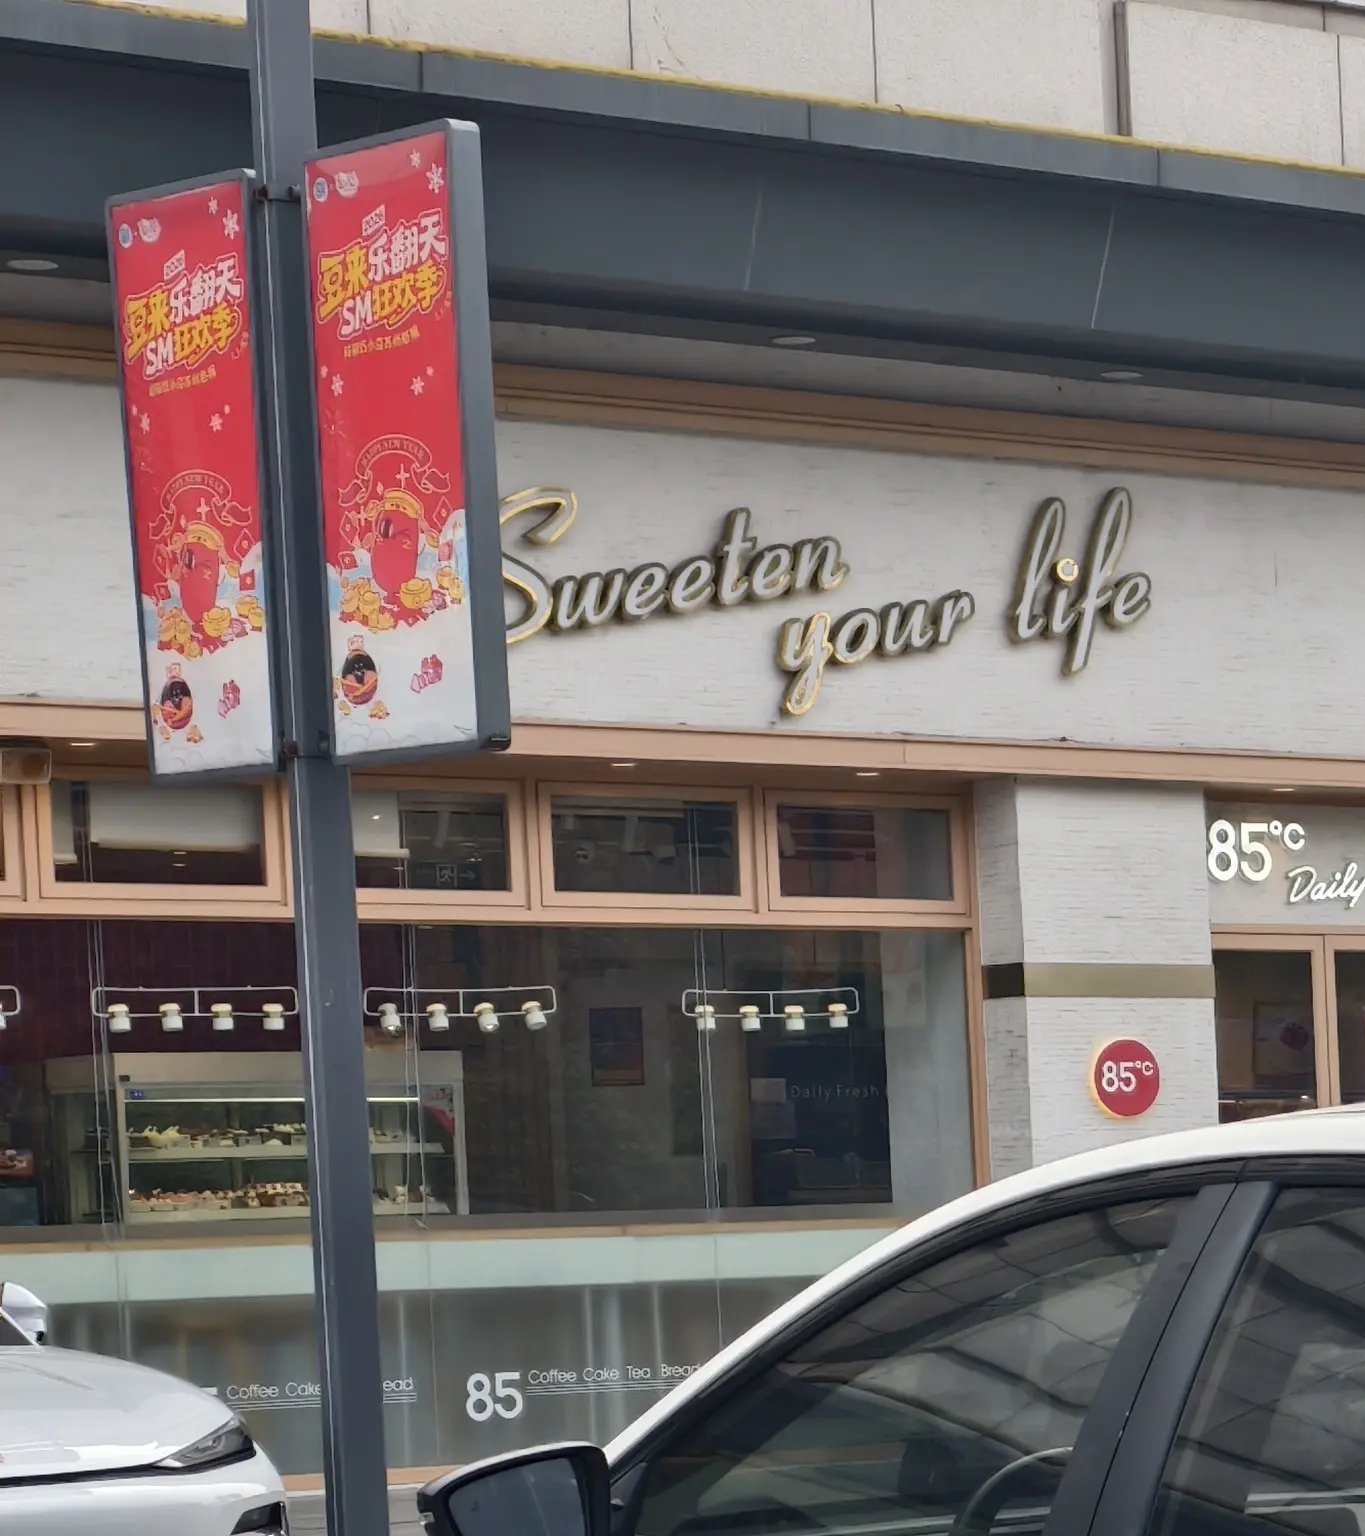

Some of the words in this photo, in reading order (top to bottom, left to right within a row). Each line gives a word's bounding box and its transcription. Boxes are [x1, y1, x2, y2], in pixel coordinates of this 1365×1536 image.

[319, 214, 446, 318] 豆来乐翻天
[340, 260, 443, 335] SM狂欢季
[126, 257, 242, 359] 豆来乐翻天
[145, 302, 239, 375] SM狂欢季
[500, 486, 851, 644] Sweeten
[777, 588, 976, 716] your
[1006, 486, 1152, 677] life
[791, 1085, 832, 1103] Daily
[836, 1084, 879, 1098] Fresh
[226, 1384, 279, 1399] Coffee
[285, 1381, 321, 1397] Cake
[466, 1372, 524, 1422] 85
[528, 1370, 577, 1385] Coffee
[583, 1367, 620, 1382] Cake
[626, 1364, 651, 1379] Tea
